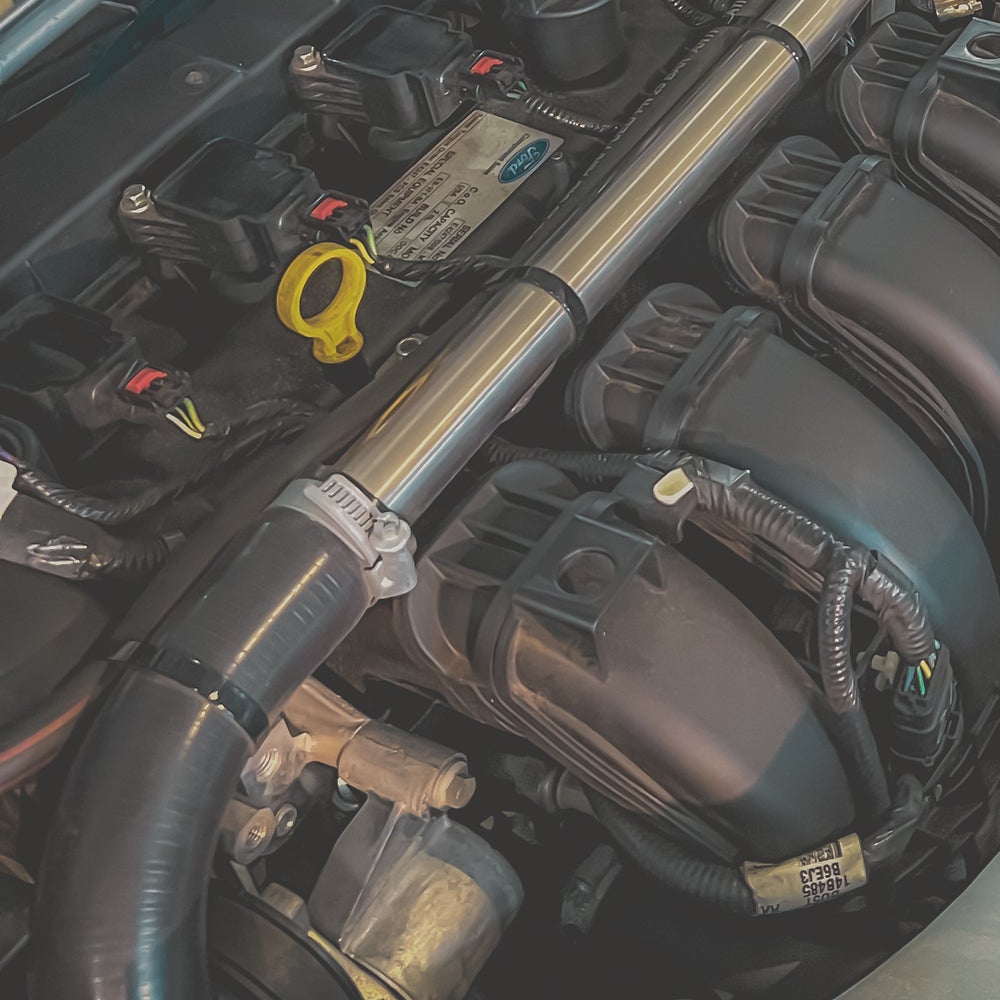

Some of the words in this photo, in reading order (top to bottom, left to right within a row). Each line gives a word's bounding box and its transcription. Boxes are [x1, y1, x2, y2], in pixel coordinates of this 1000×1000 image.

[423, 149, 456, 178] SPECIAL
[503, 144, 545, 177] Ford
[381, 176, 427, 217] EQUIPMENT
[404, 202, 430, 224] BUILD
[417, 207, 457, 243] CAPACITY
[440, 223, 472, 251] SERIAL
[799, 862, 841, 884] B6EJ3
[802, 874, 850, 898] 14B485
